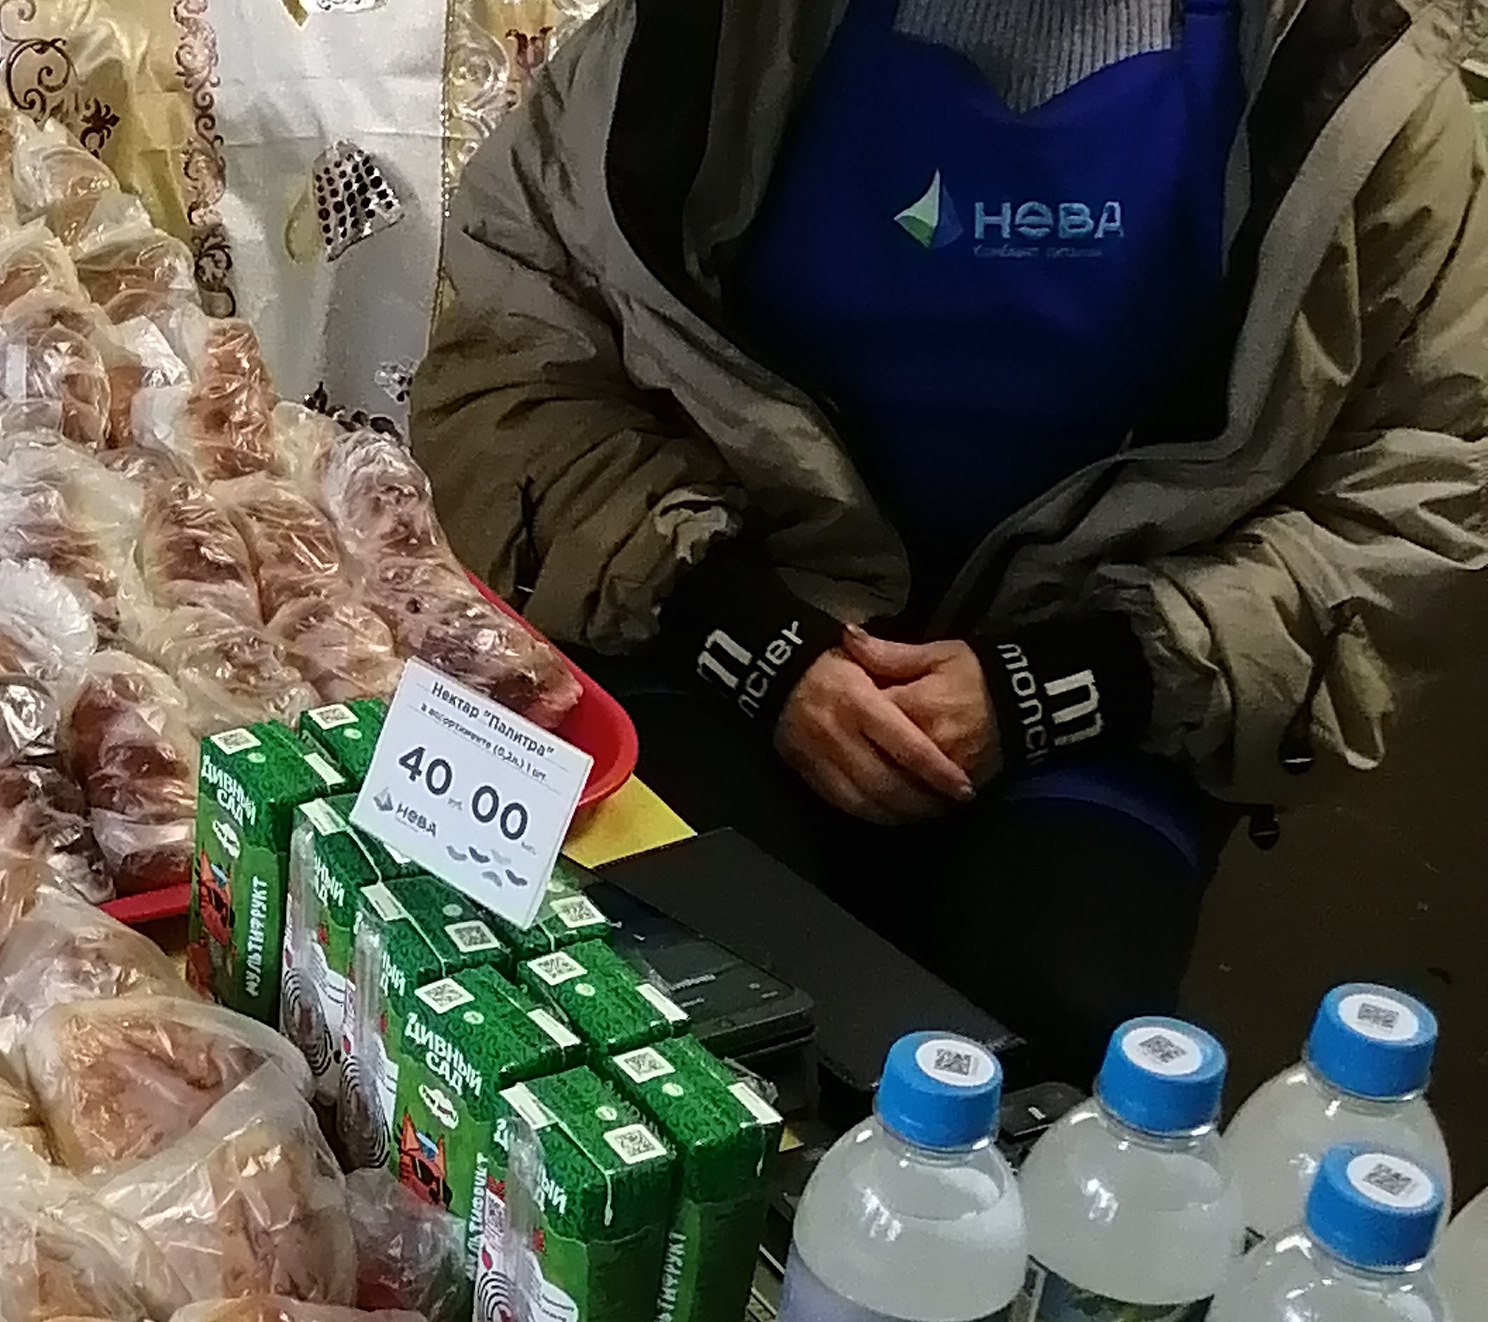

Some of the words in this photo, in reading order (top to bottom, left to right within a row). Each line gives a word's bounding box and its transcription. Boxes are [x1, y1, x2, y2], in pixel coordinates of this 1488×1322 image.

[427, 706, 493, 751] ассортименте
[431, 681, 480, 718] Нектар
[484, 709, 555, 758] "Палитра"
[201, 754, 257, 827] ДИВНЫЙ
[216, 787, 245, 827] САД
[398, 745, 453, 796] 40
[471, 784, 529, 842] 00
[245, 876, 268, 998] МУЛЬТИФРУКТ
[404, 1011, 484, 1098] ДИВНЫЙ
[425, 1050, 464, 1097] САД
